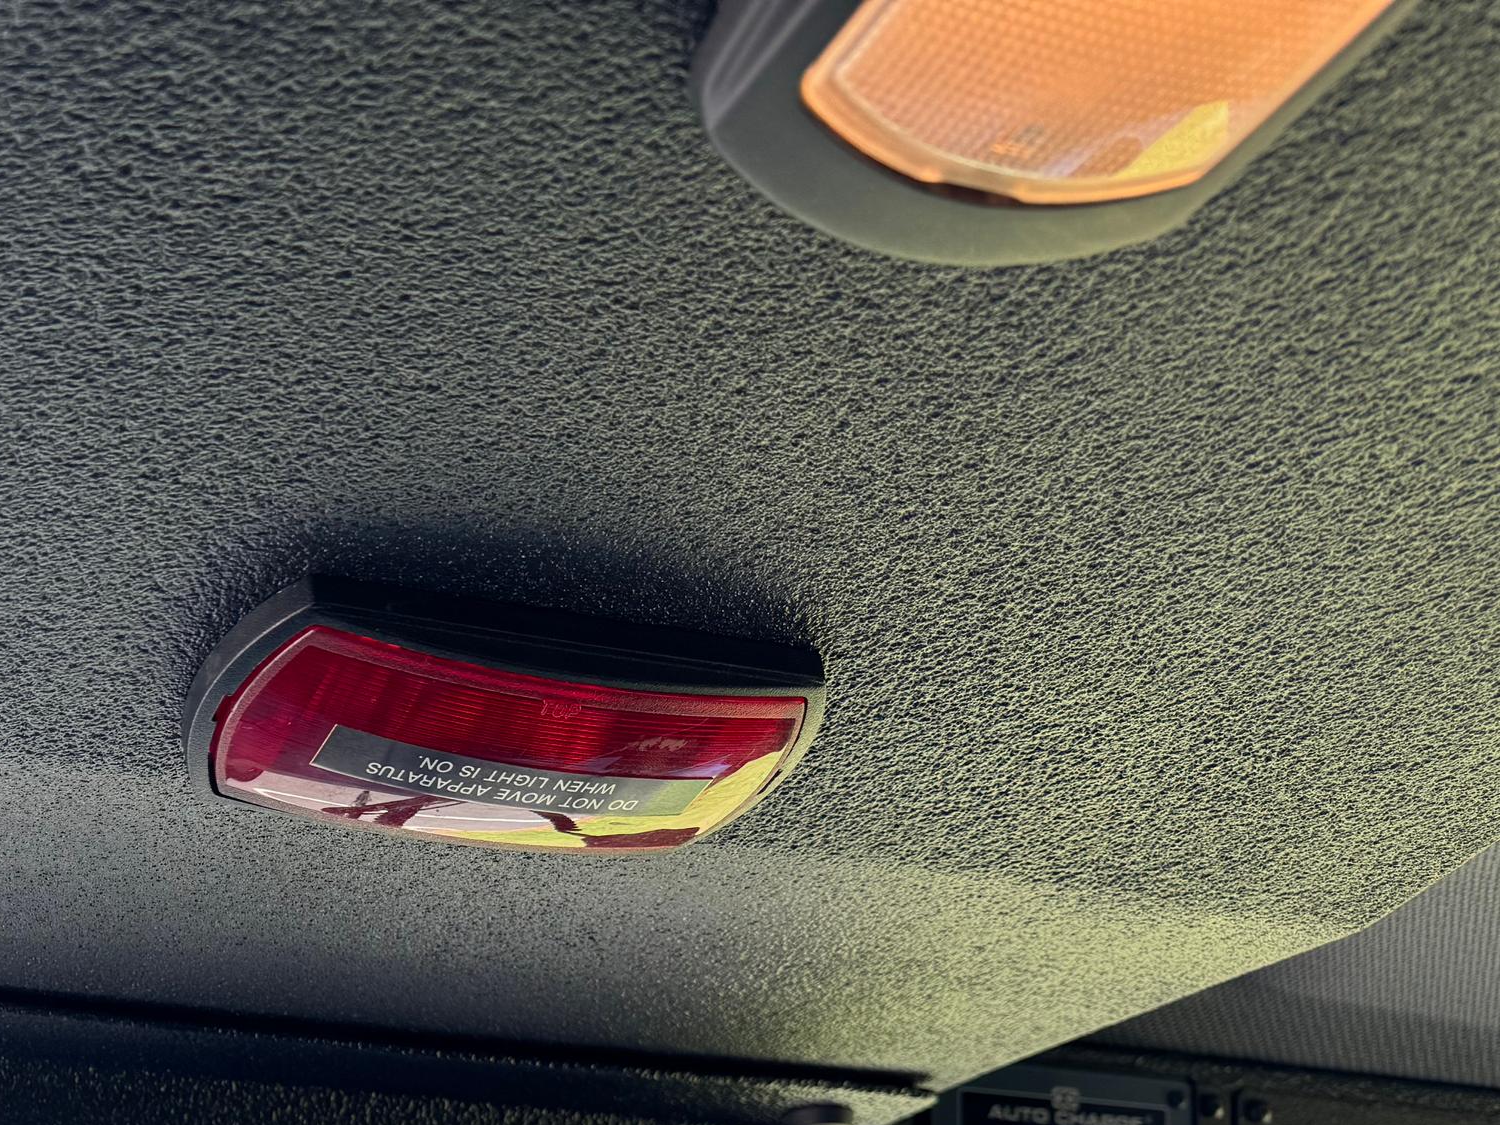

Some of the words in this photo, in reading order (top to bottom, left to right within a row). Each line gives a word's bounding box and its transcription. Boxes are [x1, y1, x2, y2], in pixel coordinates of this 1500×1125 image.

[417, 755, 454, 774] ON.
[457, 766, 480, 780] IS
[366, 762, 492, 798] APPARATUS
[487, 769, 549, 788] LIGHT
[555, 777, 616, 795] WHEN
[494, 787, 556, 805] MOVE
[562, 794, 604, 811] NOT
[608, 798, 638, 812] DO
[987, 1103, 1050, 1125] AUTO
